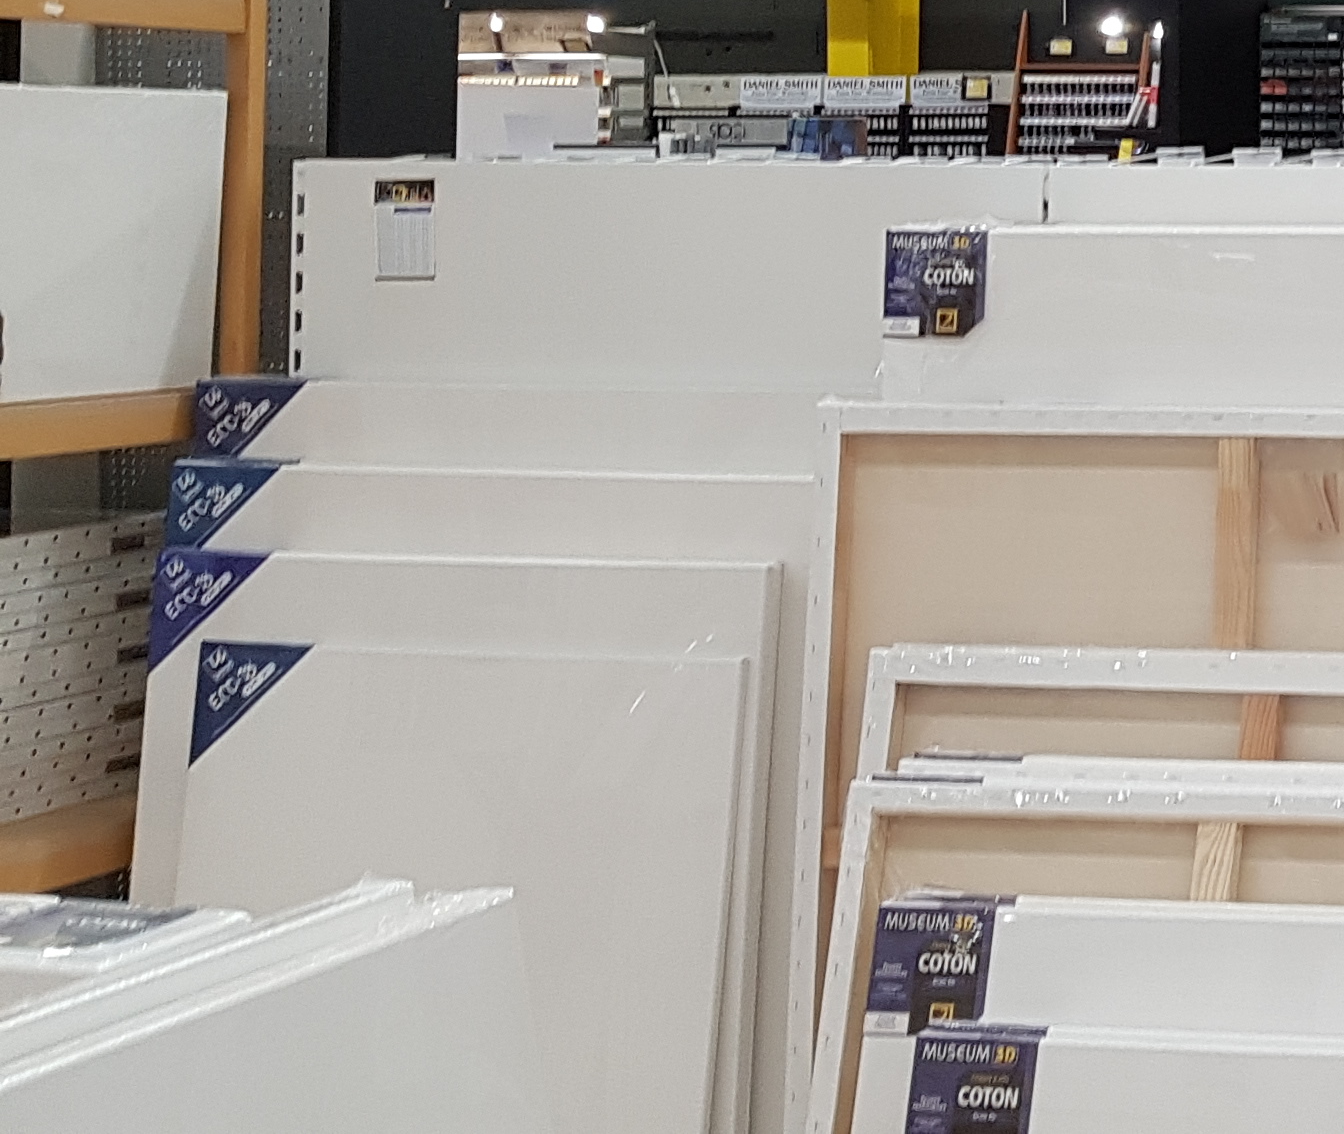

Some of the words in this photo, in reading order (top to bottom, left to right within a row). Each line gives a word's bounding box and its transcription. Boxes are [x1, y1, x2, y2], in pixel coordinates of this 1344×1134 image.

[743, 78, 781, 91] DANIEL
[783, 78, 819, 90] SMITH
[827, 78, 866, 91] DANIEL
[868, 78, 904, 90] SMITH
[892, 233, 950, 250] MUSEUM
[923, 267, 975, 285] COTON
[884, 911, 950, 932] MUSEUM
[953, 913, 975, 932] 3D
[918, 951, 978, 975] COTON
[921, 1041, 990, 1063] MUSEUM
[995, 1044, 1017, 1064] 3D
[957, 1085, 1020, 1109] COTON
